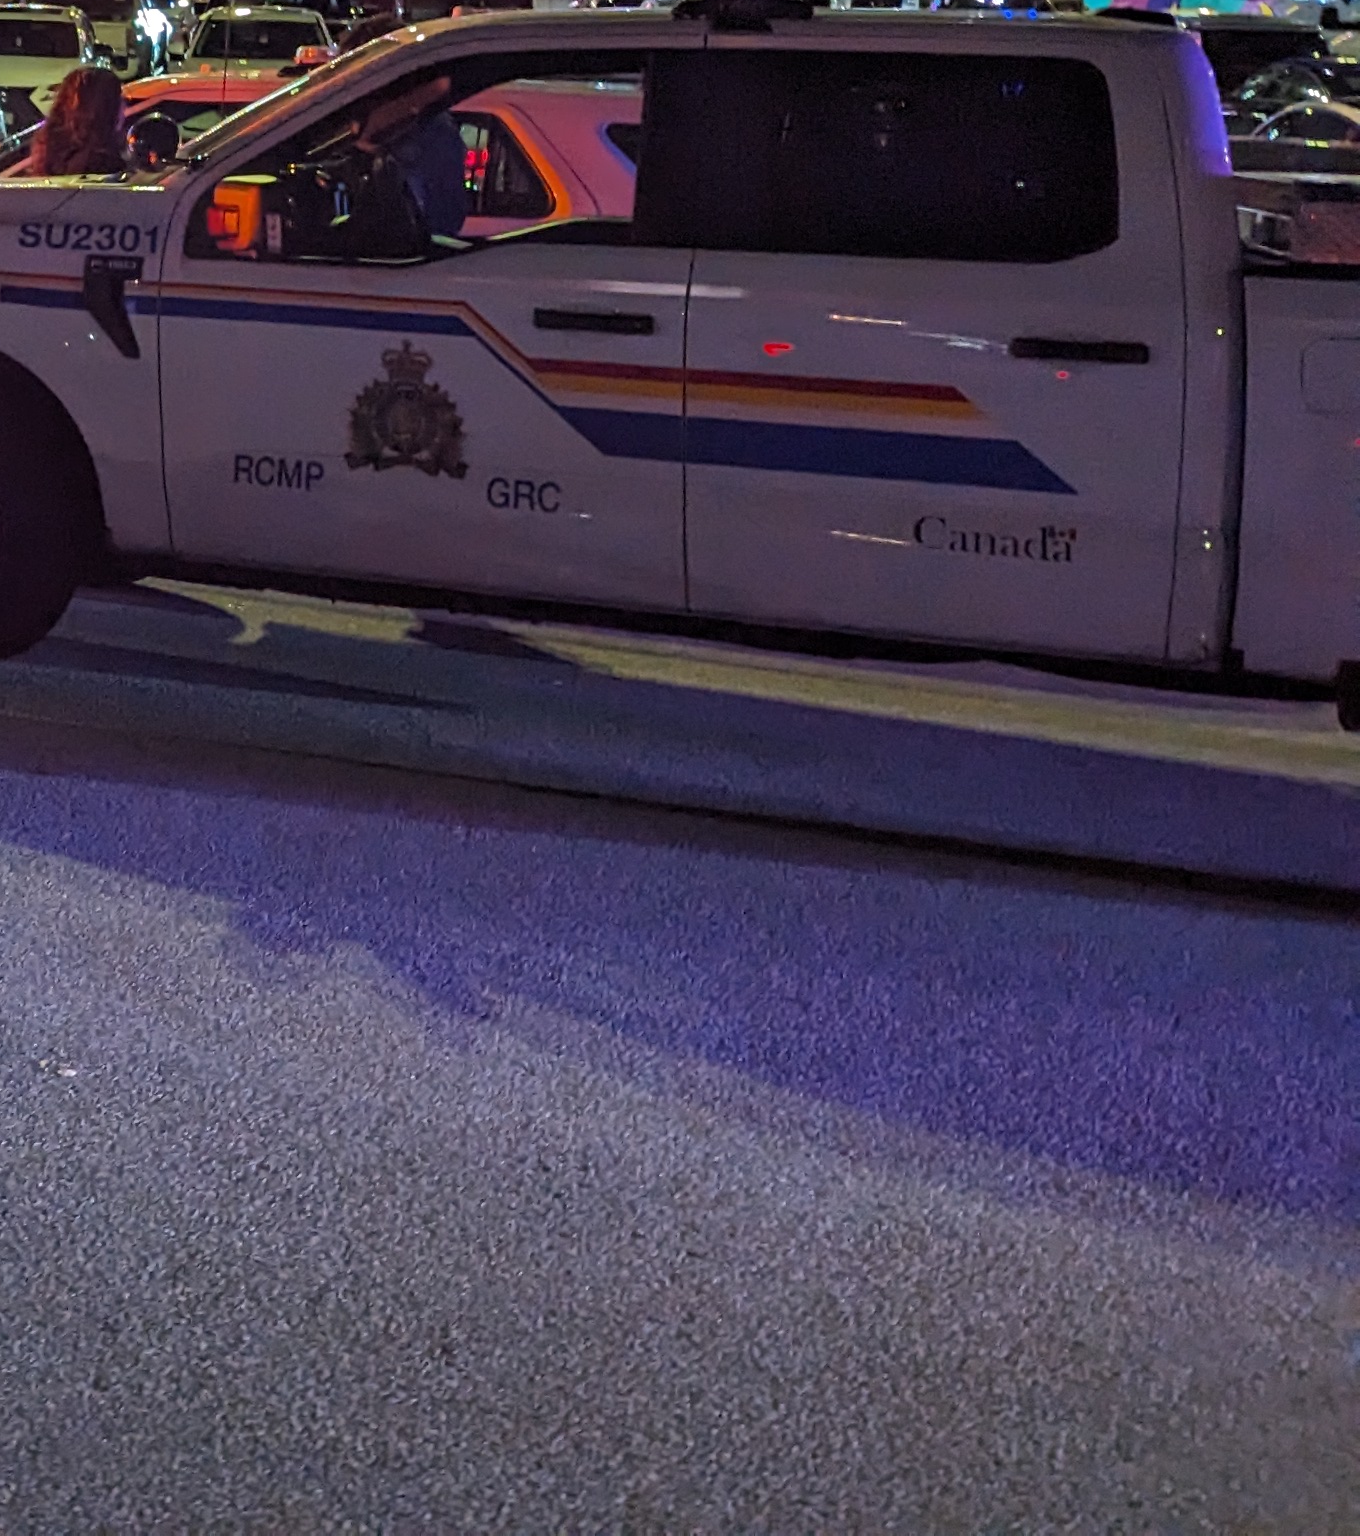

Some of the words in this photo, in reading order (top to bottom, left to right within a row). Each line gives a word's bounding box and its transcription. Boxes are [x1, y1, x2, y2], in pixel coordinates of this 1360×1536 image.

[18, 213, 159, 255] SU2301
[233, 454, 326, 492] RCMP
[486, 477, 561, 513] GRC
[913, 515, 1077, 562] Canada
